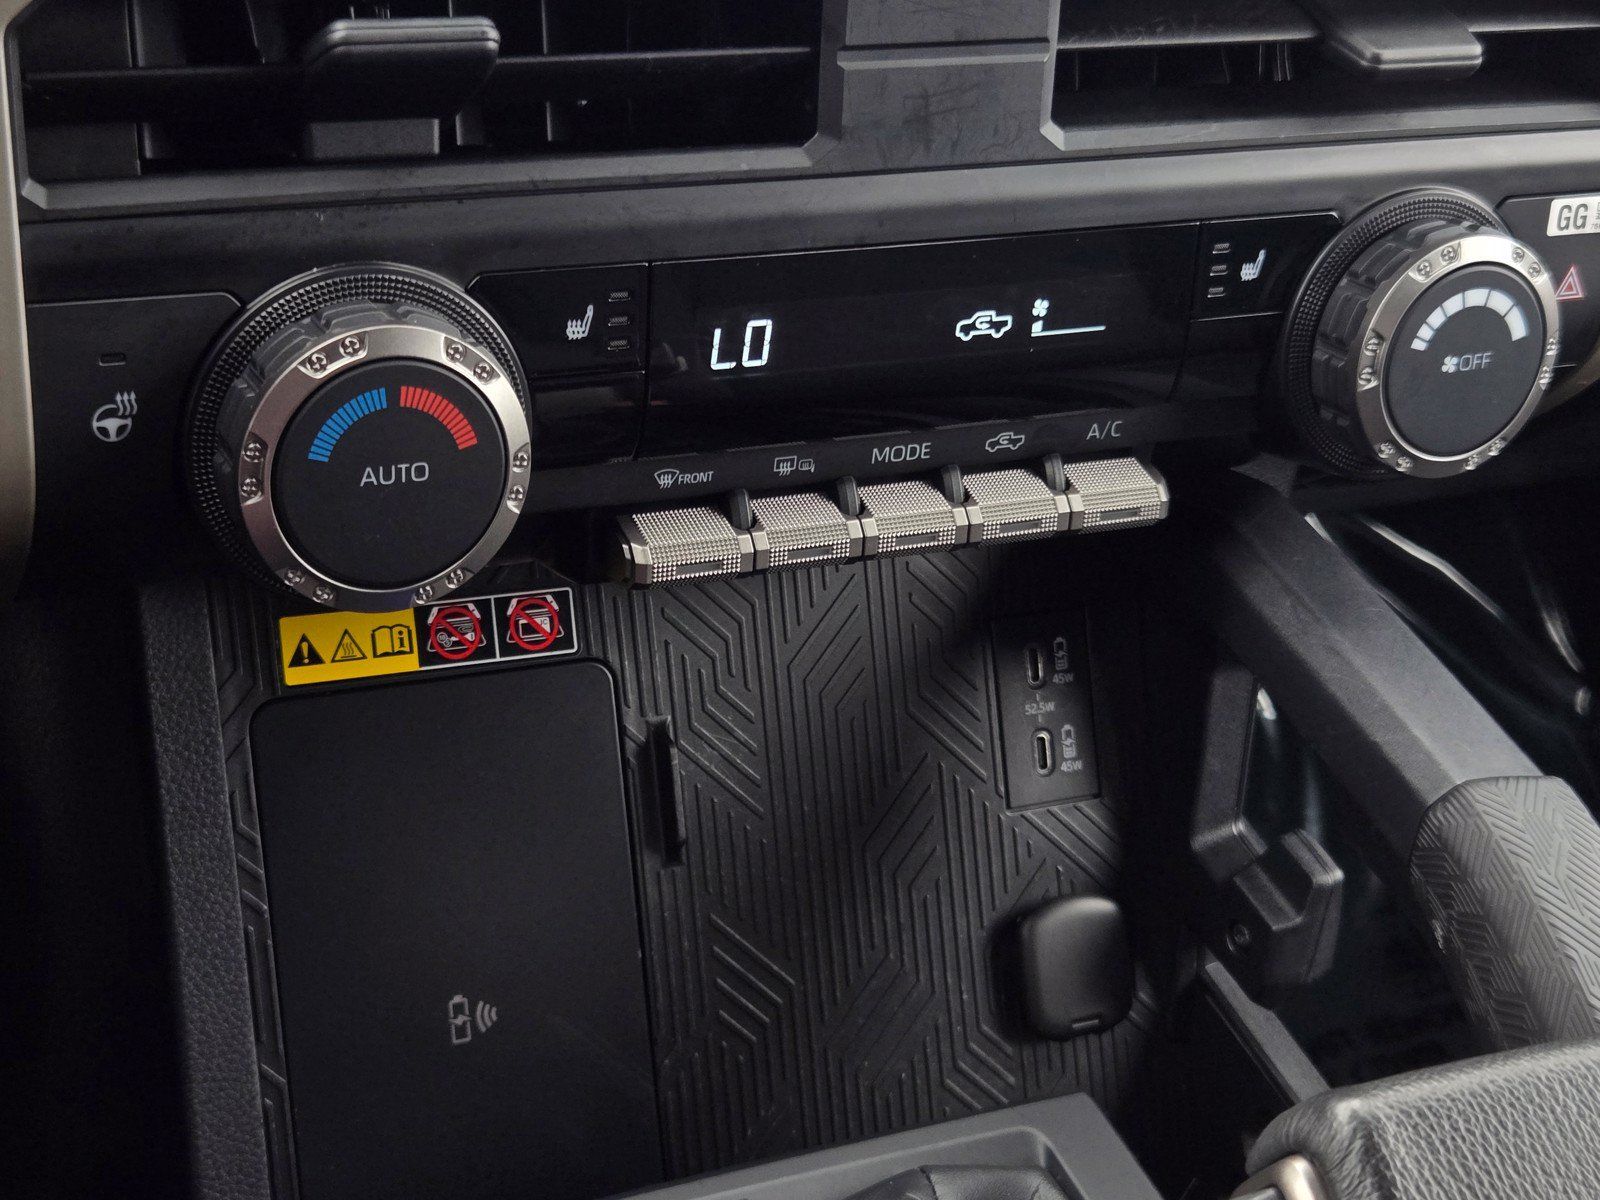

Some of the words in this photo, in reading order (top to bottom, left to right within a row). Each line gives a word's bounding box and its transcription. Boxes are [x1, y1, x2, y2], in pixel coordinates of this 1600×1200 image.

[1557, 203, 1588, 231] GG
[1460, 352, 1492, 371] OFF
[1086, 420, 1123, 440] A/C
[871, 442, 931, 464] MODE
[360, 462, 429, 487] AUTO
[678, 471, 714, 485] FRONT
[1052, 673, 1074, 684] 45W
[1025, 702, 1055, 715] 52.5W
[1061, 760, 1083, 772] 45W
